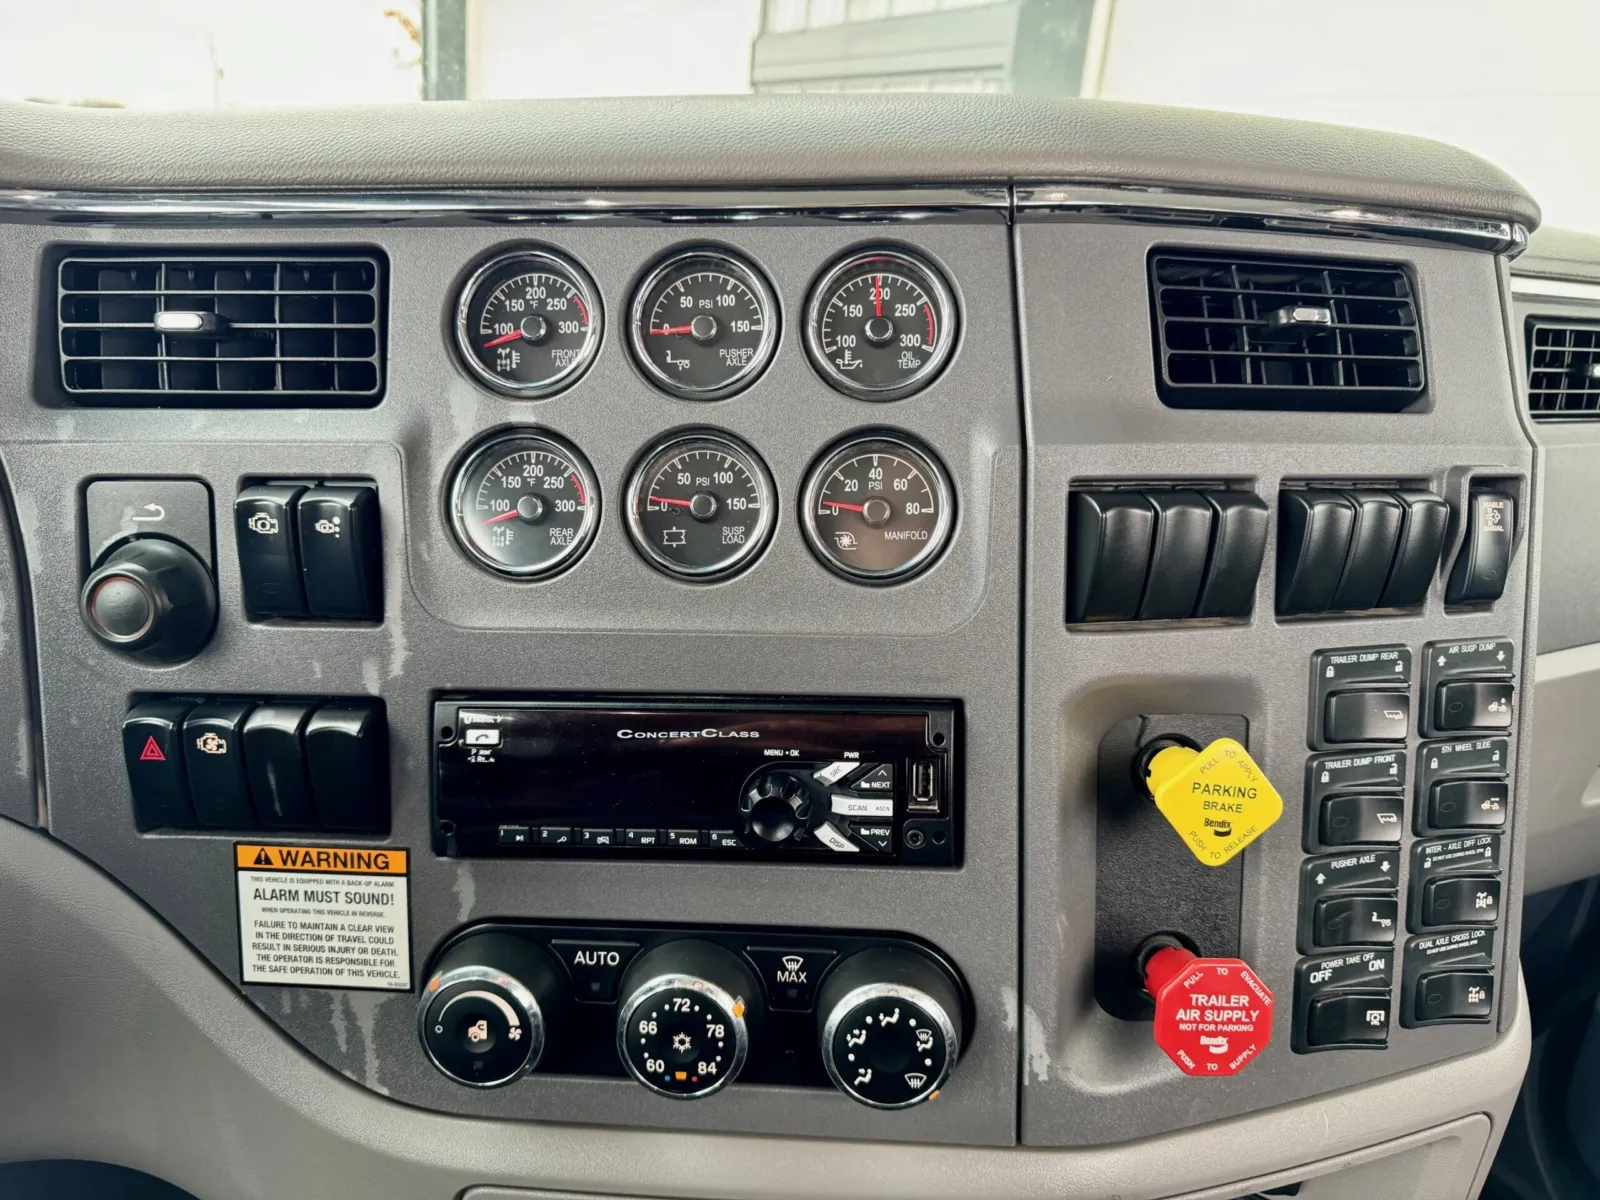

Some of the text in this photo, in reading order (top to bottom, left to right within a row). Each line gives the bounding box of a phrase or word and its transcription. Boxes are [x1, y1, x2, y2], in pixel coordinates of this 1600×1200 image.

[526, 286, 546, 299] 200
[869, 288, 890, 300] 200
[504, 299, 524, 311] 150
[546, 298, 567, 310] 250
[680, 296, 693, 307] 50
[699, 300, 713, 308] PSI
[716, 295, 735, 306] 100
[842, 305, 862, 317] 150
[895, 304, 916, 316] 250
[494, 323, 514, 335] 100
[558, 321, 579, 334] 300
[731, 321, 749, 332] 150
[836, 335, 856, 347] 100
[900, 334, 921, 346] 300
[551, 349, 582, 359] FRONT
[720, 349, 753, 358] PUSHER
[901, 351, 915, 360] OIL
[726, 358, 747, 366] AXLE
[897, 360, 921, 369] TEMP
[523, 465, 543, 477] 200
[868, 468, 883, 480] 40
[501, 476, 521, 488] 150
[543, 477, 564, 488] 250
[677, 473, 690, 485] 50
[696, 477, 710, 486] PSI
[713, 472, 733, 484] 100
[844, 480, 858, 491] 20
[868, 481, 883, 490] PSI
[893, 479, 908, 491] 60
[490, 500, 510, 511] 100
[555, 500, 575, 512] 300
[661, 500, 667, 512] 0
[726, 498, 746, 510] 150
[906, 503, 920, 515] 80
[832, 505, 839, 516] 0
[550, 528, 574, 537] REAR
[722, 527, 745, 535] SUSP
[885, 531, 928, 540] MANIFOLD
[550, 537, 572, 545] AXLE
[722, 535, 745, 544] LOAD
[1449, 642, 1496, 654] AIR SUSP DUMP
[1330, 651, 1399, 664] TRAILER DUMP REAR
[1455, 743, 1473, 752] WHEEL
[1476, 741, 1491, 750] SLIDE
[844, 751, 859, 759] PWR
[1200, 750, 1258, 783] PULL TO APPLY
[1324, 754, 1396, 770] TRAILER DUMP FRONT
[871, 781, 891, 789] NEXT
[1191, 782, 1258, 799] PARKING
[848, 804, 868, 812] SCAN
[1202, 800, 1243, 814] BRAKE
[1204, 818, 1231, 829] Bendix
[870, 828, 890, 836] PREV
[679, 837, 697, 845] RDM
[722, 838, 737, 847] ESC
[829, 837, 845, 850] DISP
[1189, 825, 1258, 860] PUSH TO RELEASE
[1425, 837, 1492, 854] INTER AXLE DIFF LOCK
[278, 849, 390, 870] WARNING
[1331, 854, 1376, 869] PUSHER AXLE
[253, 888, 394, 906] ALARM MUST SOUND!
[254, 919, 394, 933] FAILURE TO MAINTAIN A CLEAR VIEW
[255, 931, 394, 945] IN THE DIRECTION OF TRAVEL COULD
[1419, 940, 1434, 950] DUAL
[1435, 936, 1450, 946] AXLE
[1451, 932, 1470, 943] CROSS
[1471, 930, 1486, 938] LOCK
[252, 942, 399, 956] RESULT IN SERIOUS INJURY OR DEATH.
[256, 954, 395, 967] THE OPERATOR IS RESPONSIBLE FOR
[574, 951, 620, 966] AUTO
[1321, 952, 1375, 969] POWER TAKE OFF
[1368, 958, 1385, 971] ON
[252, 965, 401, 979] THE SAFE OPERATION OF THIS VEHICLE.
[776, 971, 807, 984] MAX
[1309, 969, 1333, 984] OFF
[1183, 967, 1273, 1006] PULL TO EVACUATE
[672, 998, 691, 1012] 72
[1190, 994, 1250, 1007] TRAILER
[1175, 1009, 1260, 1022] AIR SUPPLY
[639, 1020, 658, 1035] 66
[706, 1024, 725, 1038] 78
[1179, 1023, 1254, 1032] NOT FOR PARKING
[1177, 1043, 1257, 1071] PUSH TO SUPPLY
[646, 1059, 665, 1073] 60
[697, 1061, 717, 1075] 84
